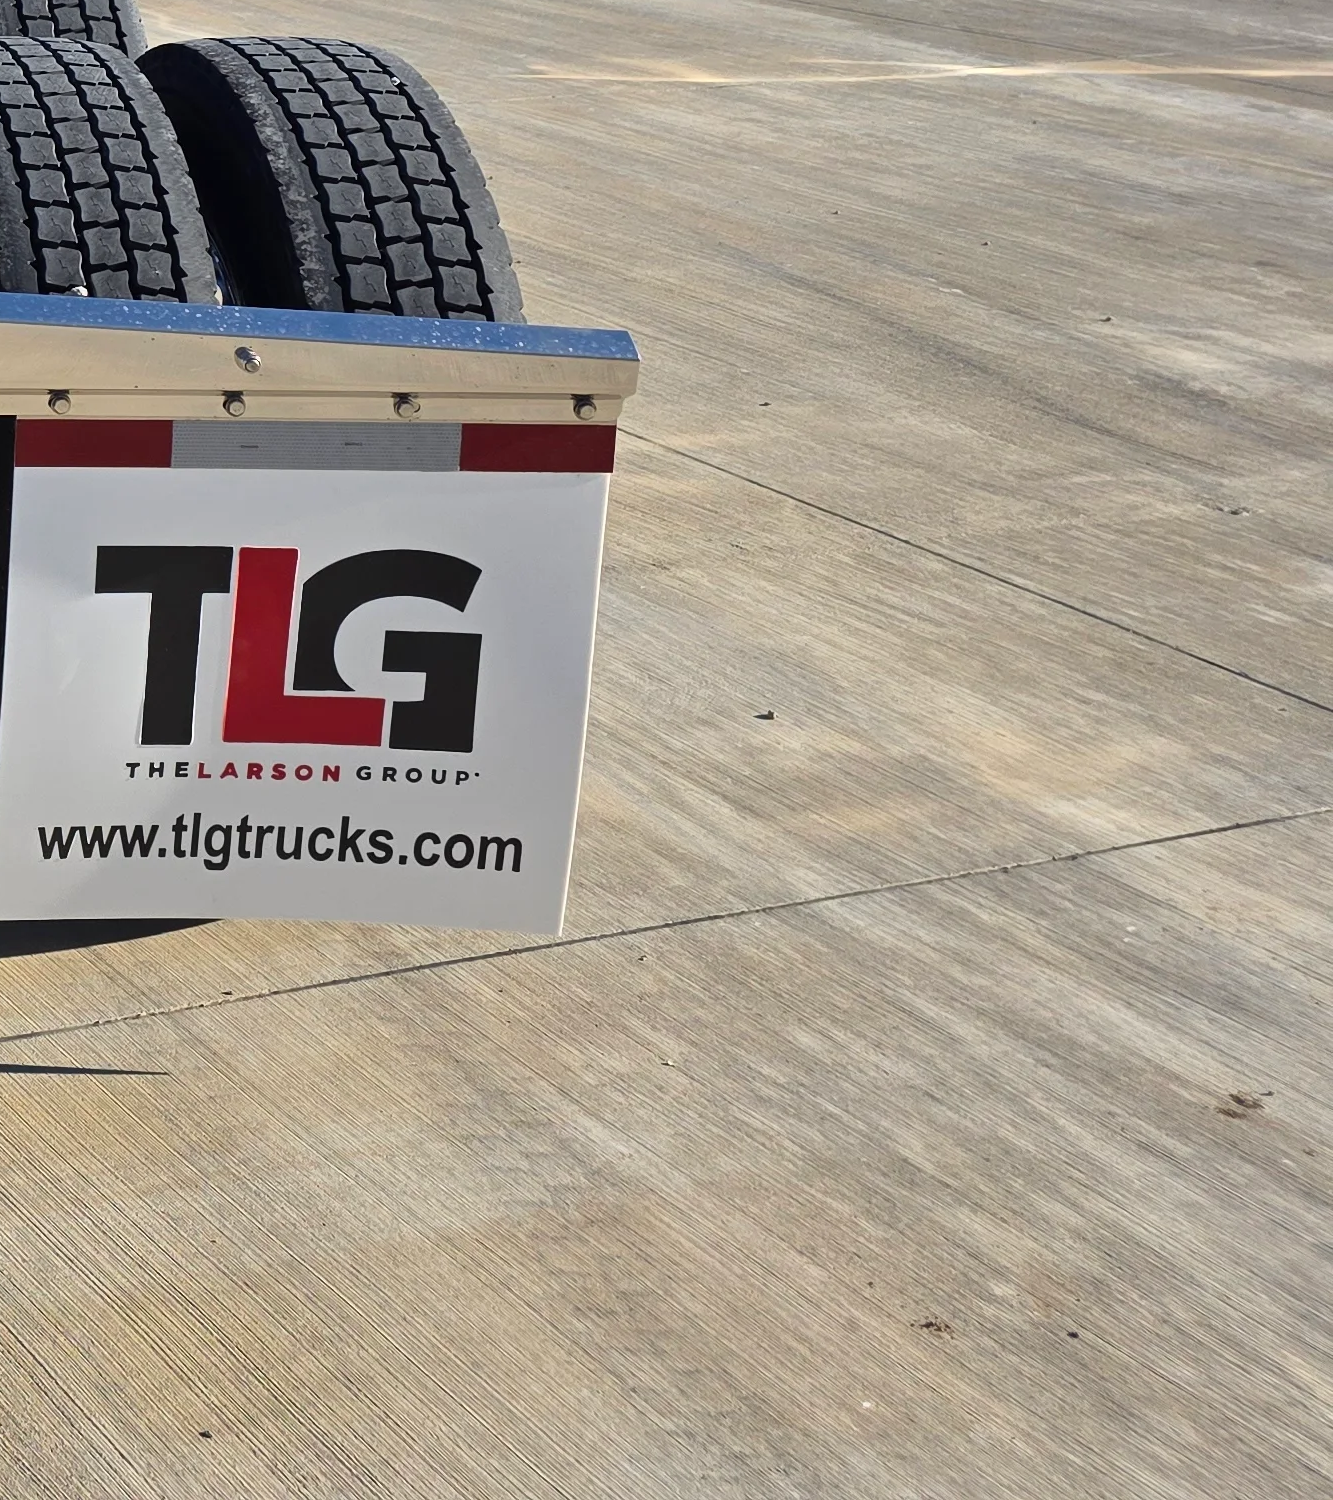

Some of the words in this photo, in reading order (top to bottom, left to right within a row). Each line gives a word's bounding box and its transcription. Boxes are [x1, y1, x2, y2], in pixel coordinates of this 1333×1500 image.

[94, 545, 483, 753] TLG
[356, 765, 470, 786] GROUP
[37, 812, 523, 873] www.tlgtrucks.com
